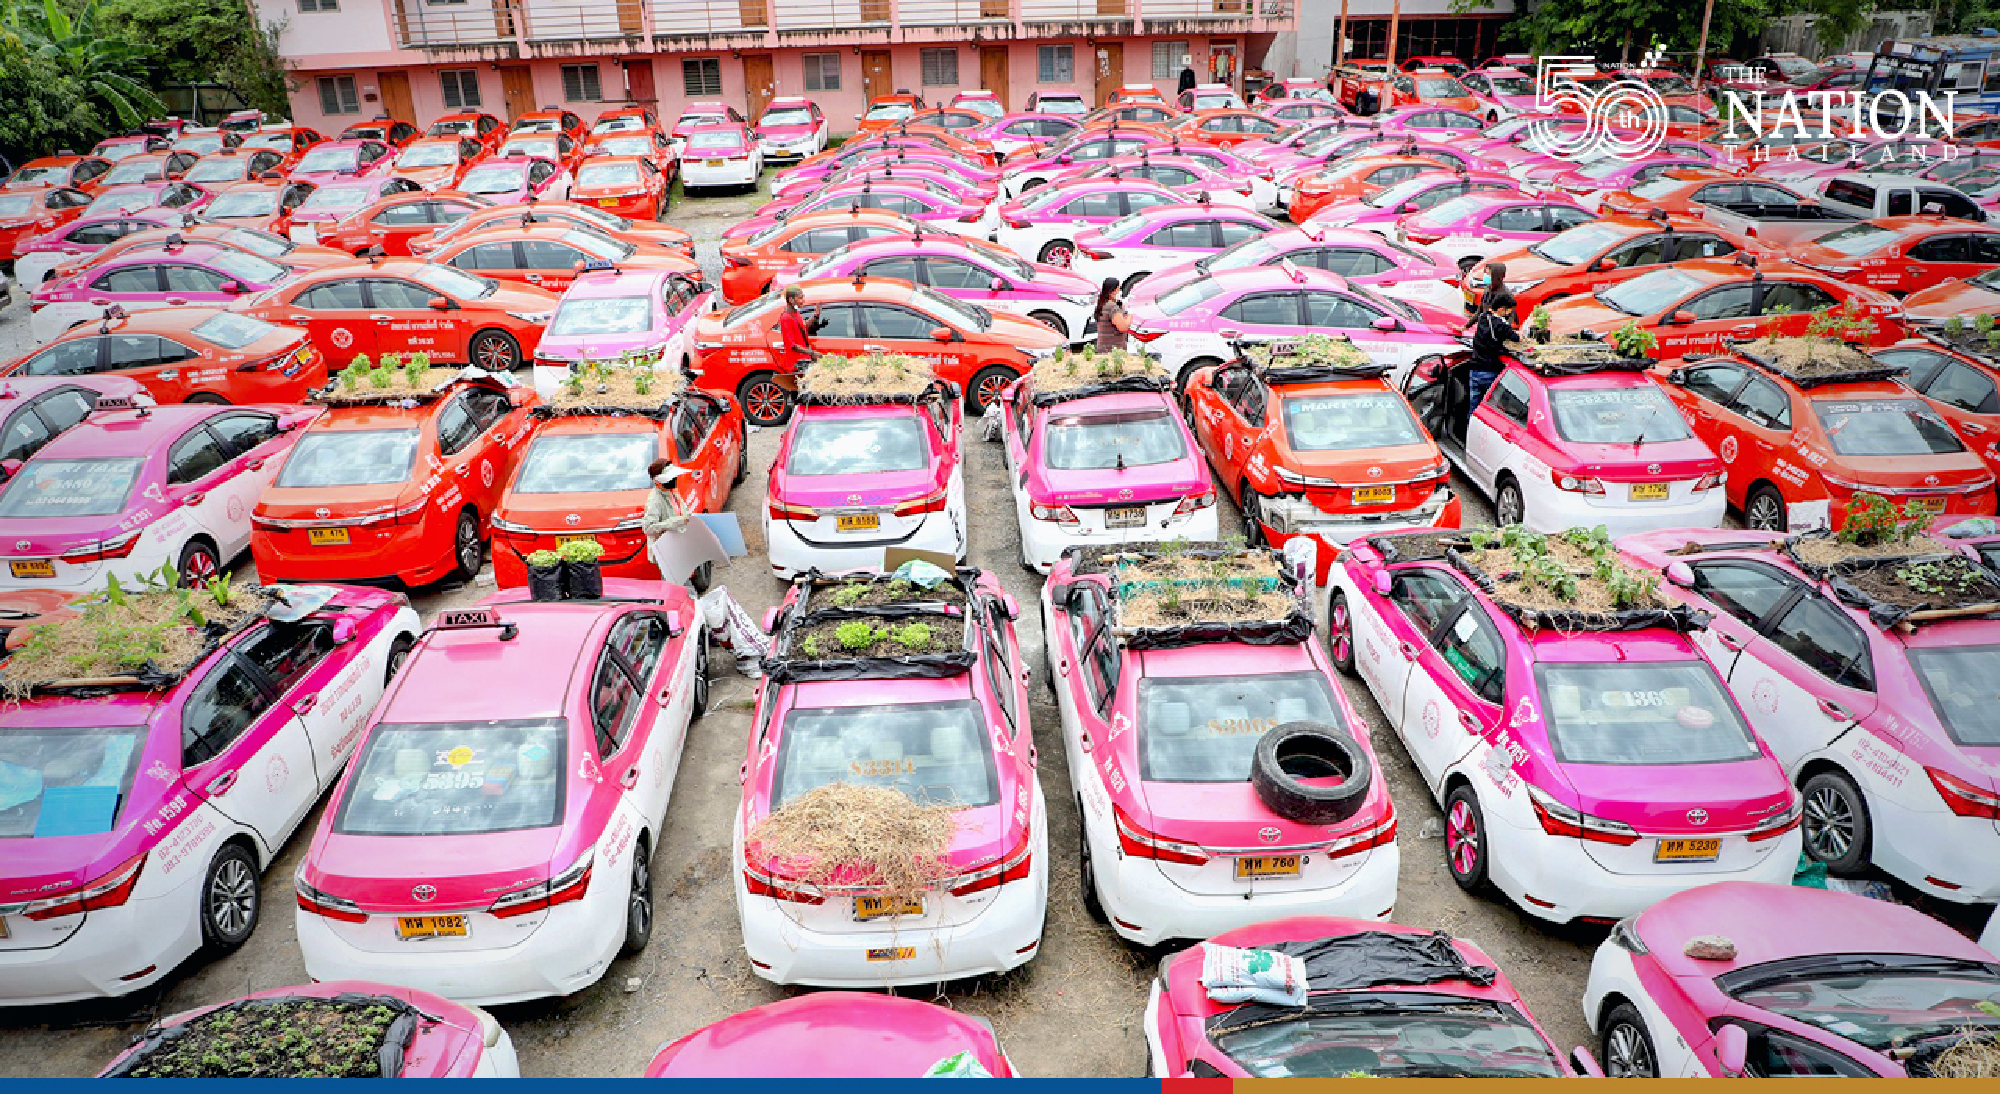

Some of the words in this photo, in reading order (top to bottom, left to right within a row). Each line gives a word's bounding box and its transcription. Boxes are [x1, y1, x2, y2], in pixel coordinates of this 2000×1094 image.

[99, 398, 128, 408] TAXI
[445, 612, 488, 625] TAXI
[1688, 839, 1718, 852] 5230
[1272, 857, 1295, 868] 760
[430, 915, 463, 928] 1082
